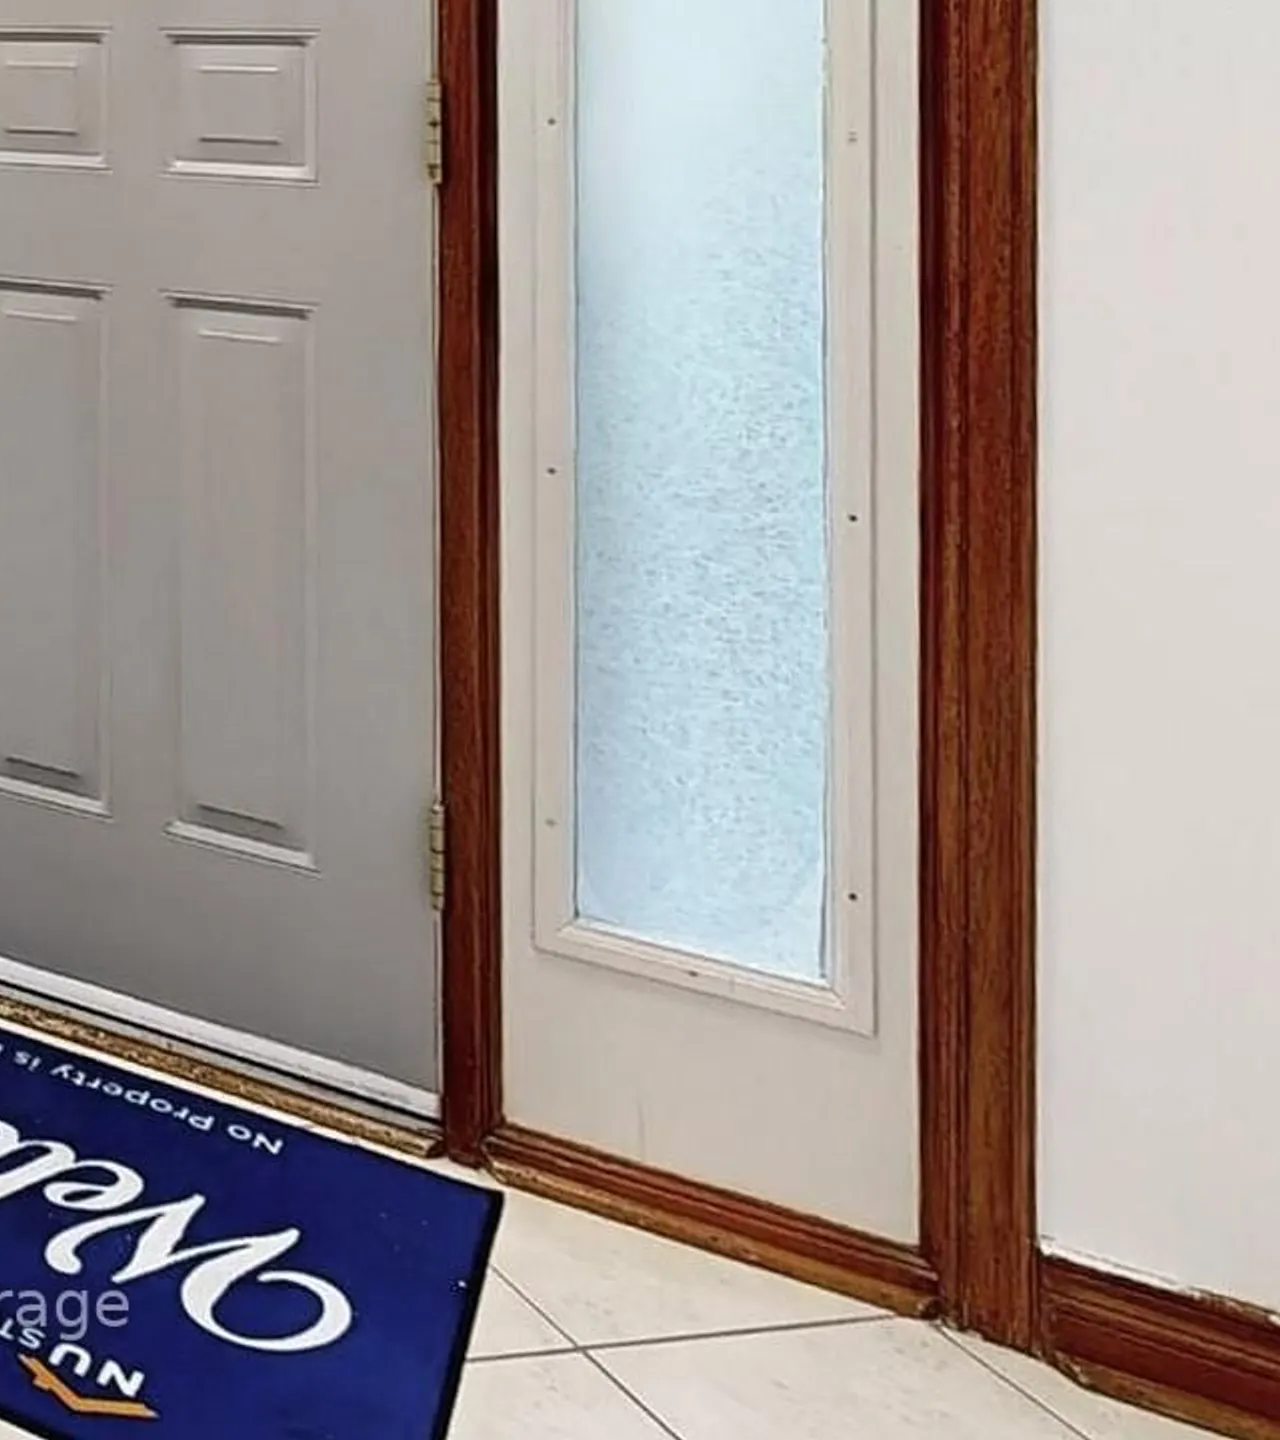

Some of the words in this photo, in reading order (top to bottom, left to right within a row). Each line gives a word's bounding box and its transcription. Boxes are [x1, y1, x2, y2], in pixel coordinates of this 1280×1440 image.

[14, 1049, 41, 1072] is
[49, 1063, 216, 1132] Property
[226, 1123, 284, 1156] No
